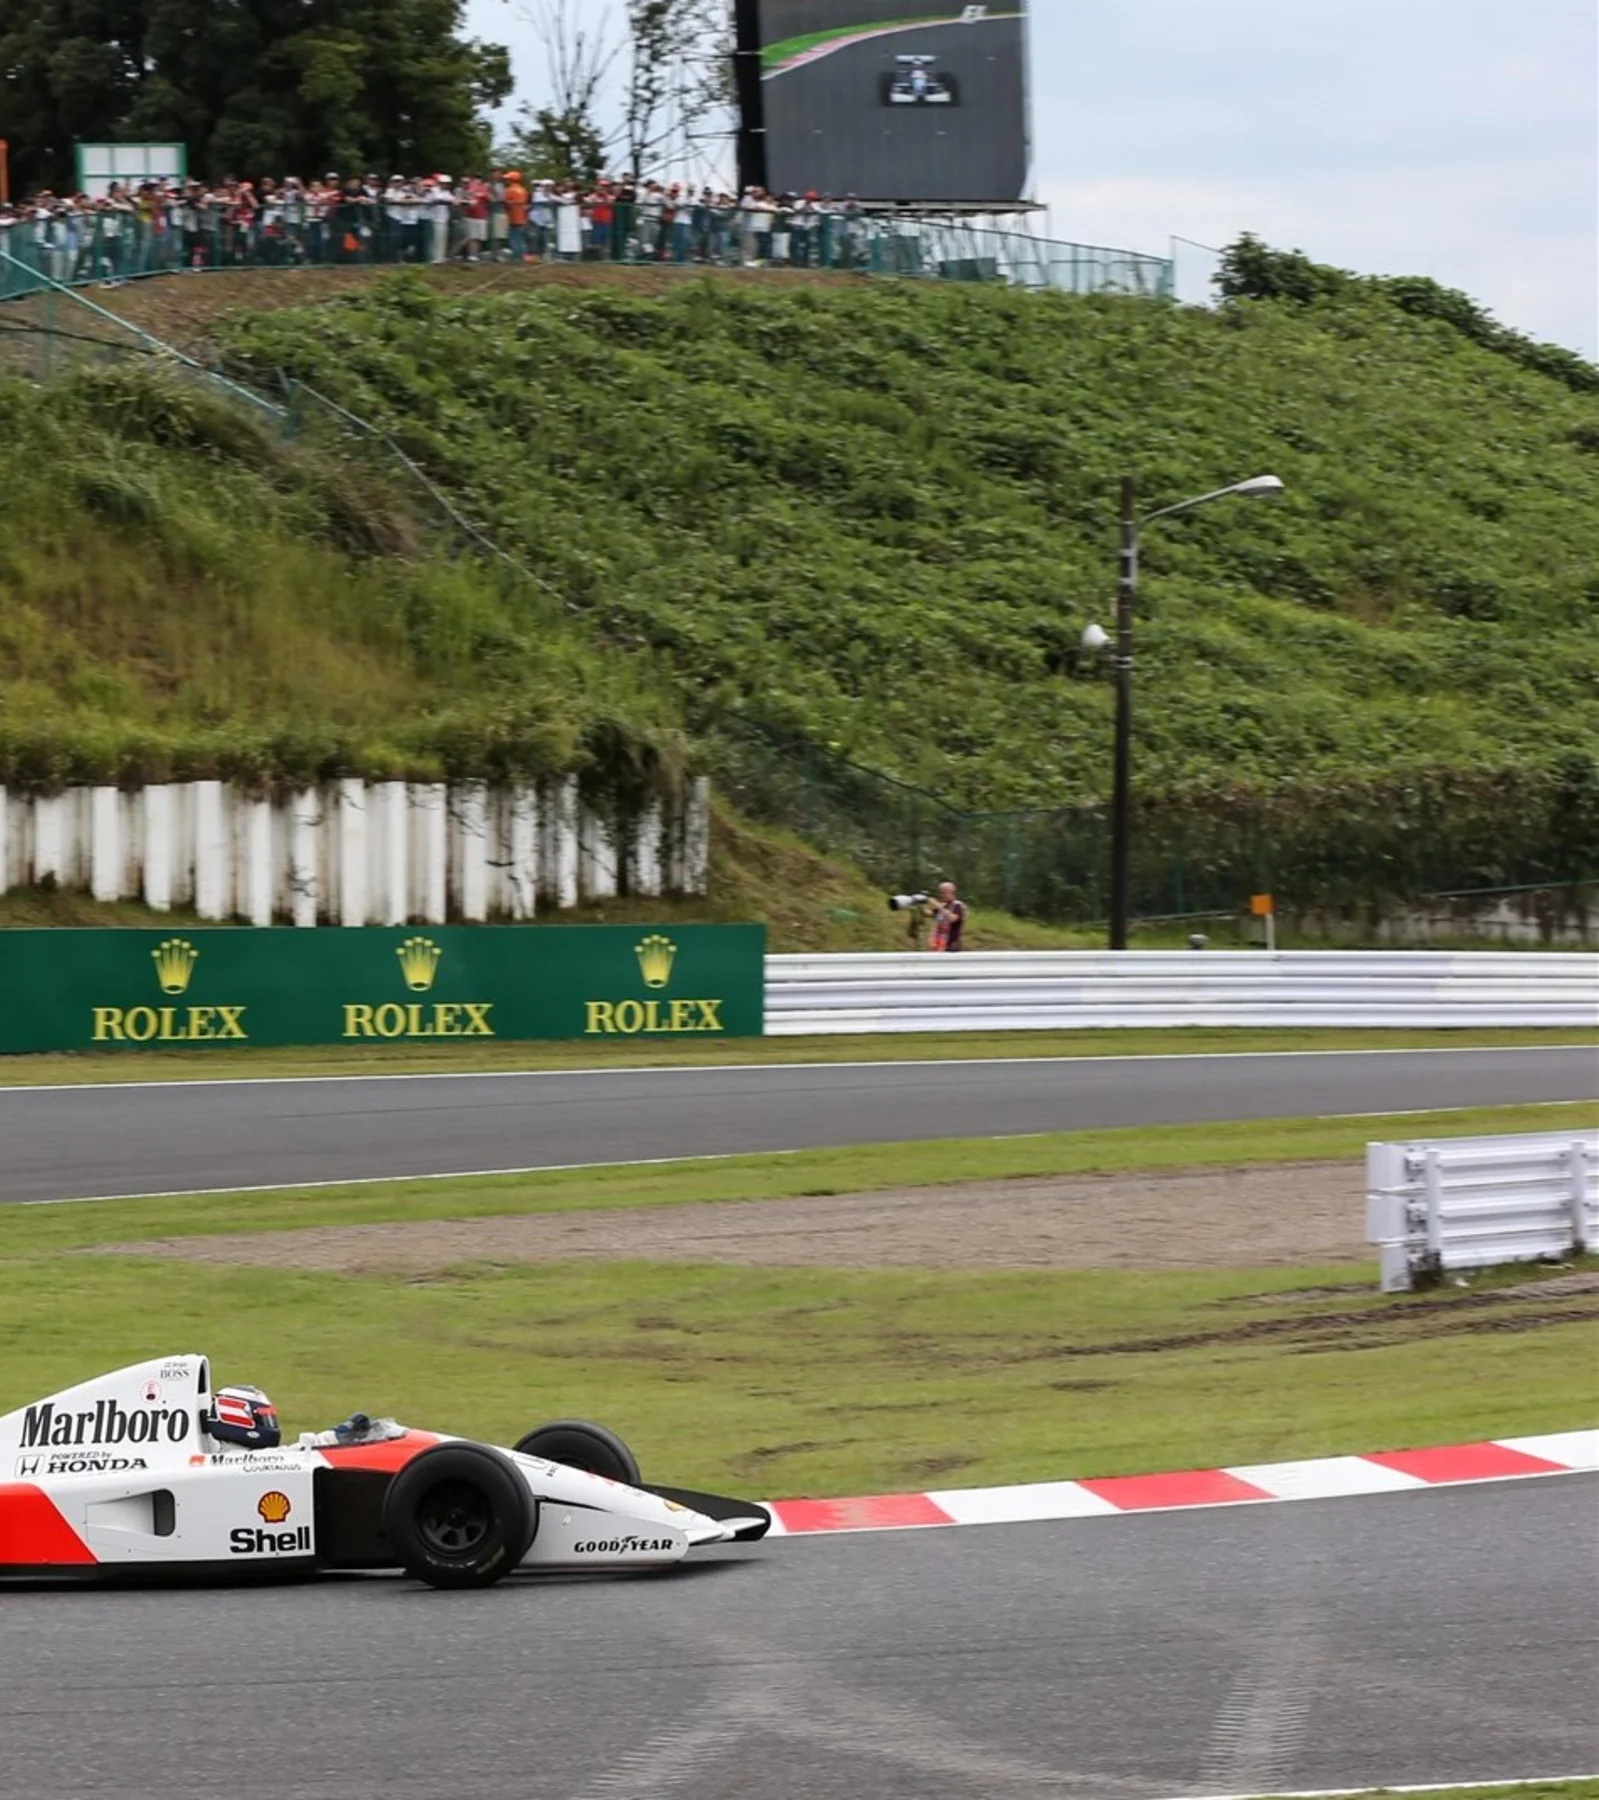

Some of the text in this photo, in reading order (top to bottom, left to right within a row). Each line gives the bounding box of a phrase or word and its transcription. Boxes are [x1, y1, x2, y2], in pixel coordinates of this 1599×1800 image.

[92, 1006, 248, 1041] ROLEX
[343, 1003, 494, 1037] ROLEX
[585, 999, 724, 1034] ROLEX
[19, 1400, 190, 1447] Marlboro
[47, 1458, 149, 1474] HONDA
[50, 1451, 100, 1460] POWERED
[210, 1454, 284, 1465] Marlboro
[229, 1526, 311, 1553] Shell
[573, 1535, 673, 1554] GOODYEAR
